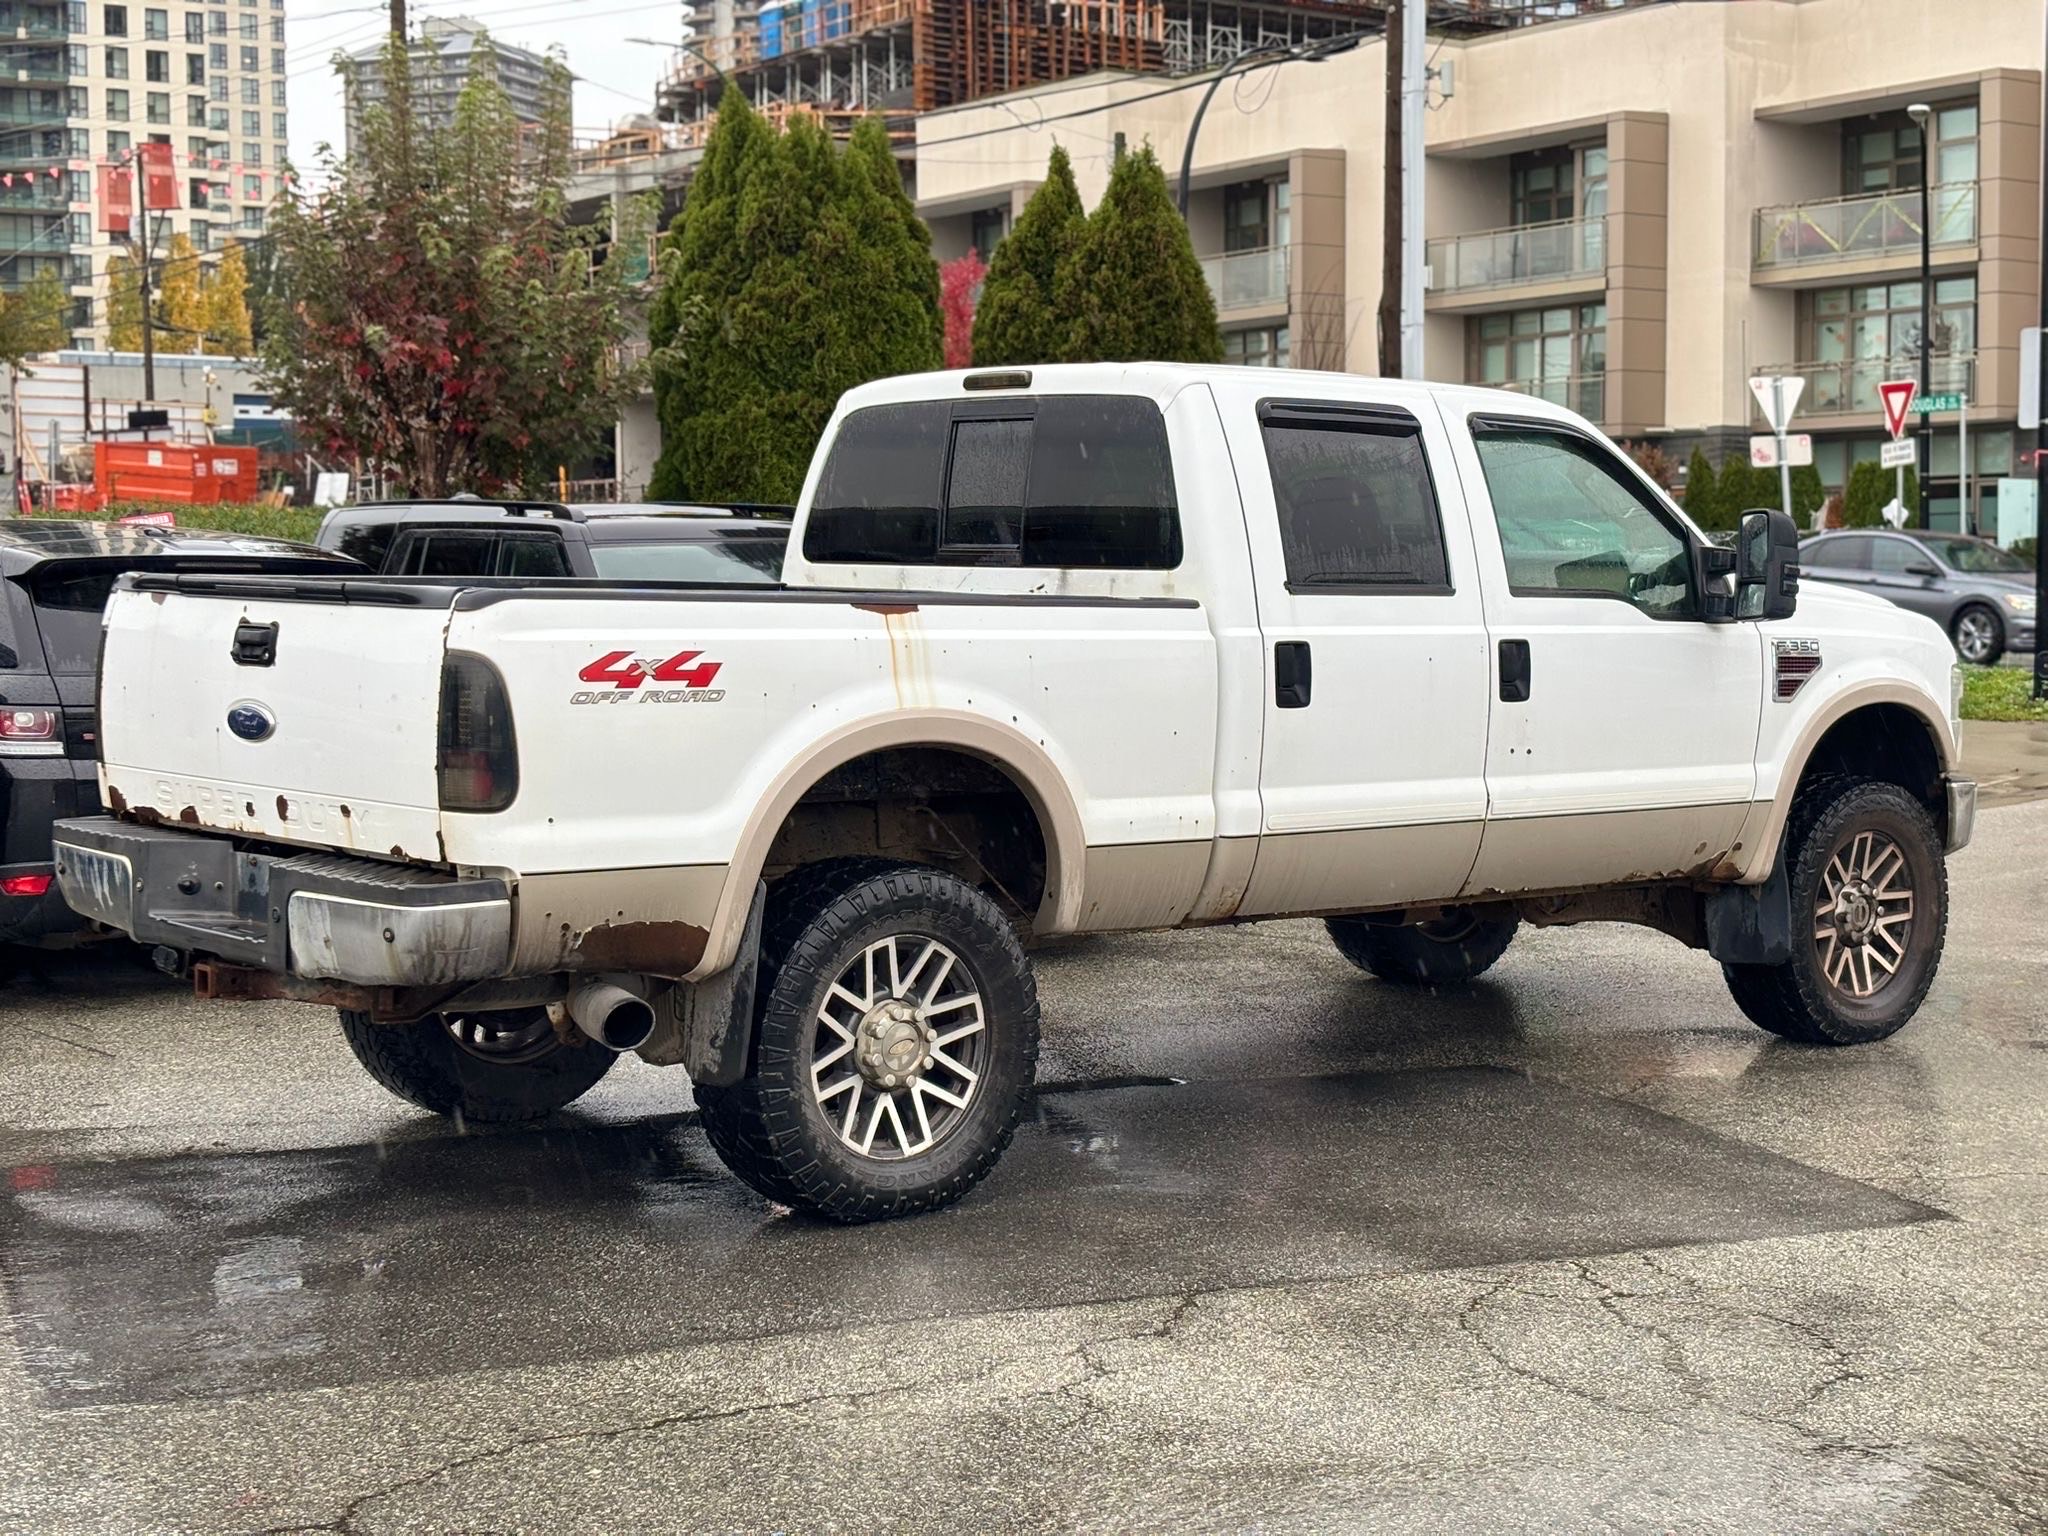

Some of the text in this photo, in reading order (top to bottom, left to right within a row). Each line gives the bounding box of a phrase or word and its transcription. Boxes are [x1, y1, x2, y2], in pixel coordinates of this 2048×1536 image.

[570, 689, 726, 704] OFF ROAD
[155, 780, 370, 839] SUPER DUTY
